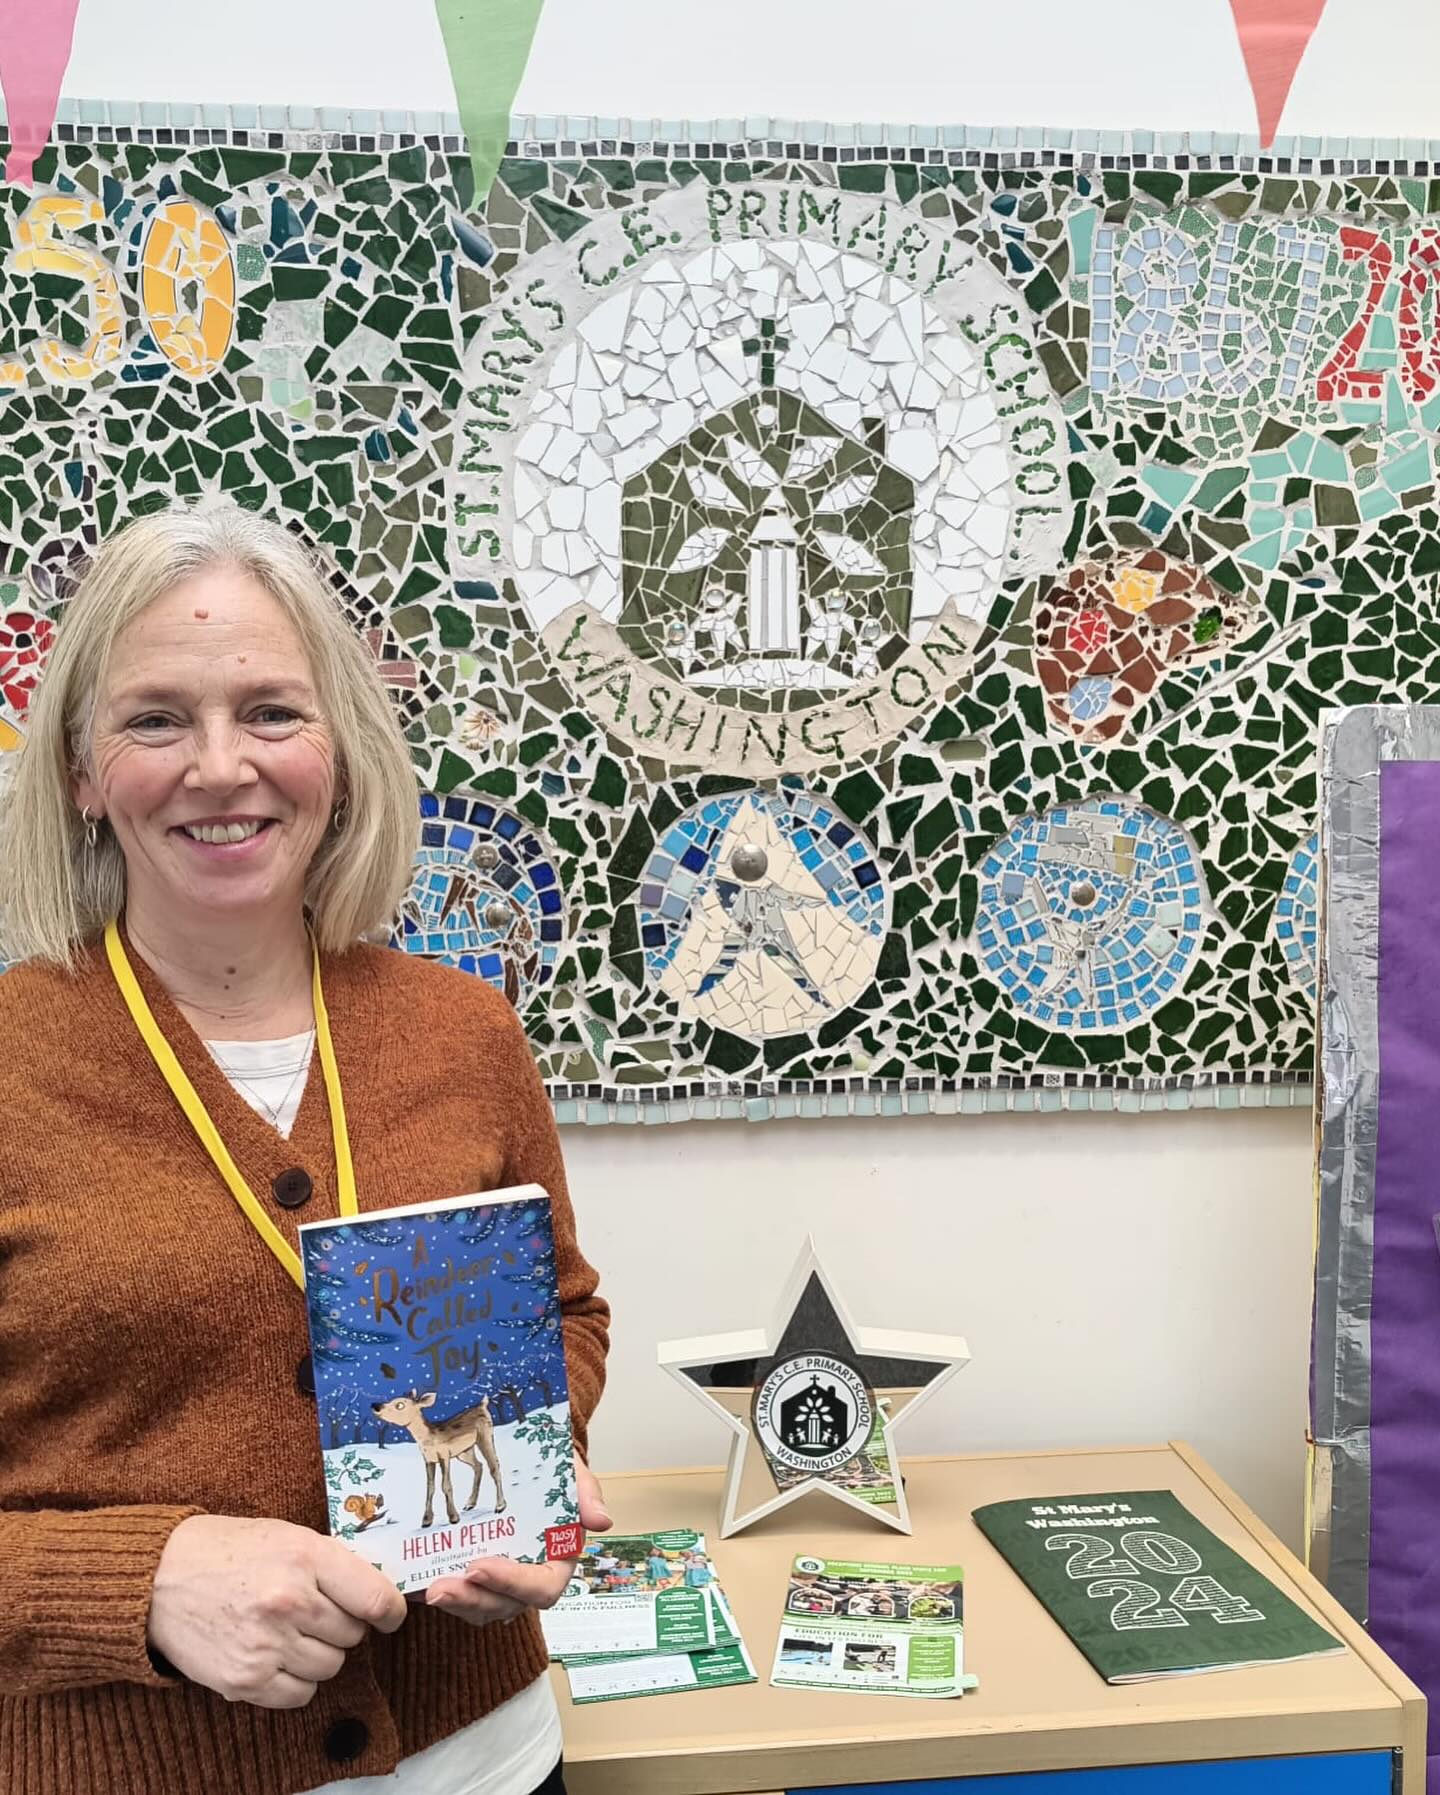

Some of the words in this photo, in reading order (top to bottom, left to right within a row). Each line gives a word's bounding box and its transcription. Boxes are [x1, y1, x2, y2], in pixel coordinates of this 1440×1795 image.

[707, 188, 974, 297] PRIMARY
[959, 304, 1063, 561] SCHOOL
[557, 614, 967, 766] WASHINGTON
[412, 1233, 430, 1270] A
[373, 1255, 497, 1326] Reindeer
[406, 1288, 493, 1342] Called
[412, 1334, 481, 1390] Joy
[806, 1358, 856, 1382] PRIMARY
[852, 1382, 870, 1428] SCHOOL
[776, 1446, 852, 1469] WASHINGTON
[1025, 1516, 1160, 1529] Washington
[1032, 1506, 1056, 1515] St
[1057, 1502, 1132, 1514] Mary's
[402, 1530, 452, 1560] HELEN
[460, 1515, 517, 1547] PETERS
[431, 1549, 475, 1565] illustrated
[550, 1527, 577, 1543] nosy
[550, 1541, 578, 1557] crow
[1045, 1531, 1202, 1579] 20
[410, 1568, 444, 1582] ELLIE
[1087, 1575, 1266, 1630] 24
